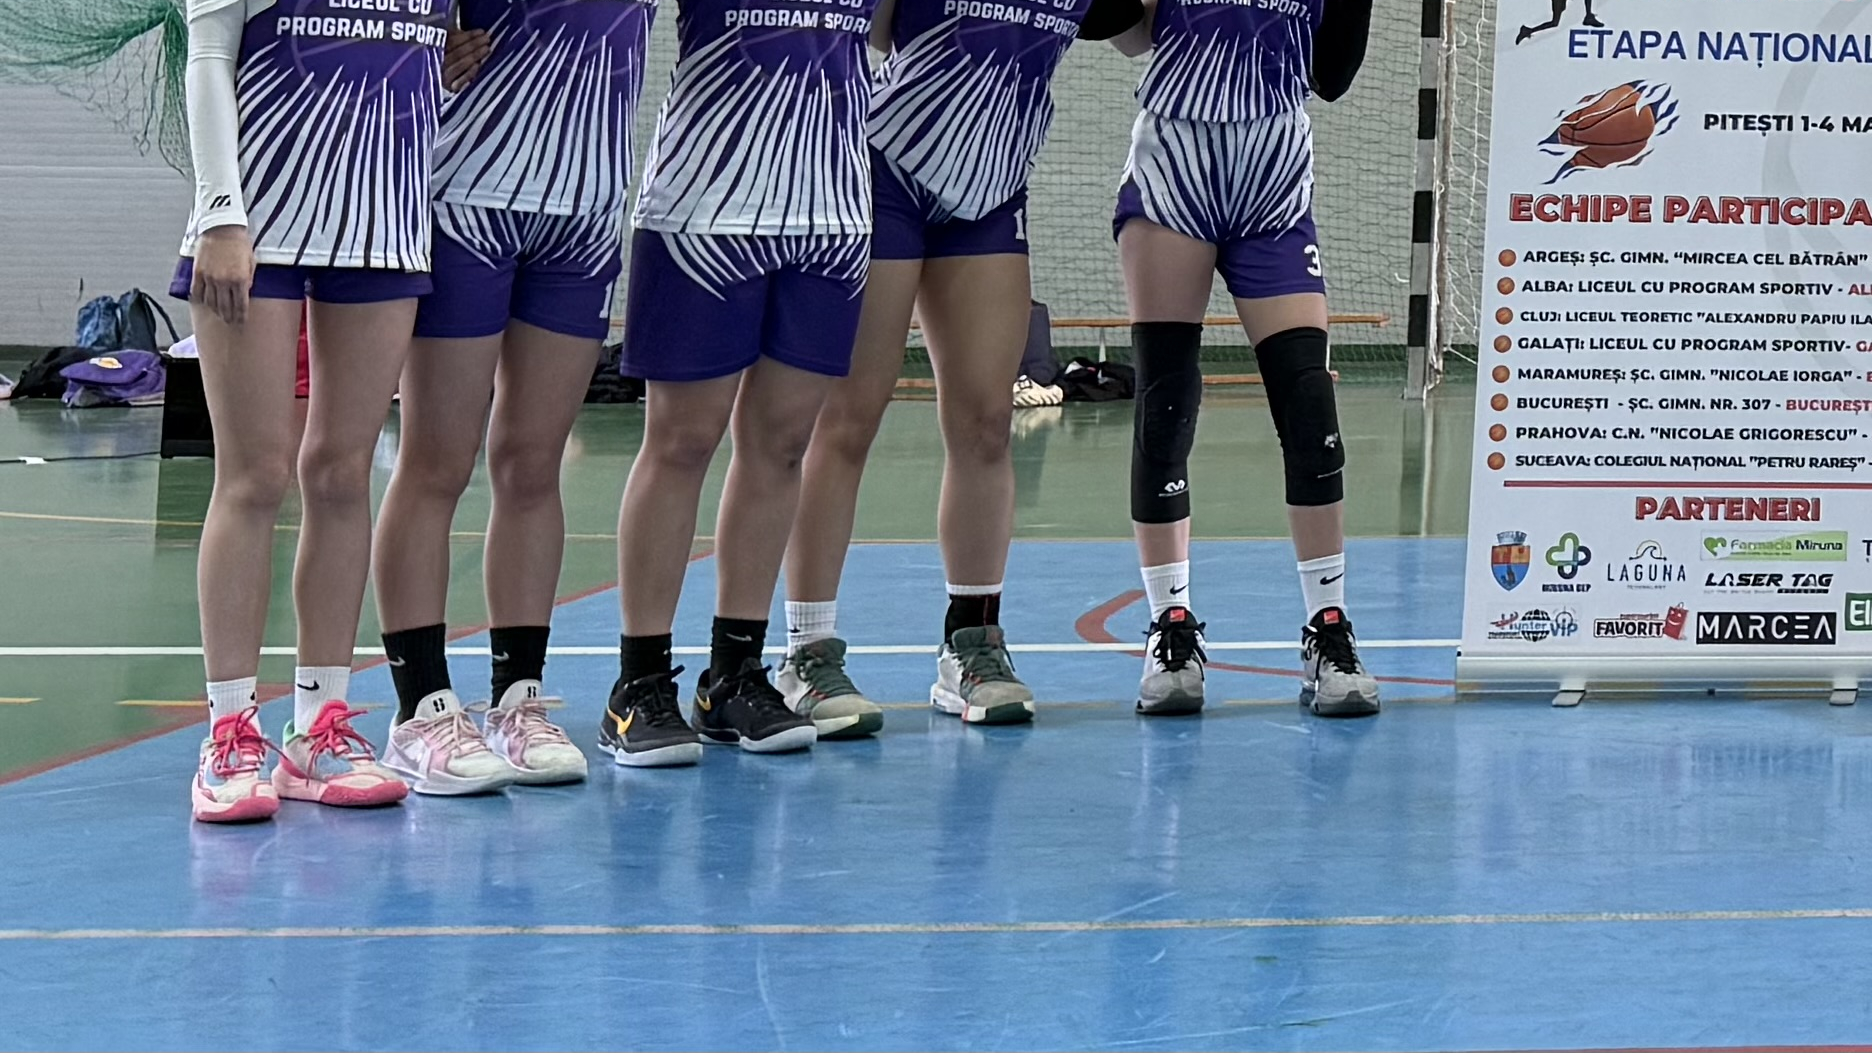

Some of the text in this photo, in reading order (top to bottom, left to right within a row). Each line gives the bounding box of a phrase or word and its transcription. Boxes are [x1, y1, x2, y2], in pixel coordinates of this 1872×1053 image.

[725, 9, 820, 28] PROGRAM
[943, 0, 1031, 25] PROGRAM
[276, 16, 385, 40] PROGRAM
[1567, 29, 1687, 61] ETAPA
[1703, 113, 1794, 138] PITEȘTI
[1800, 115, 1835, 133] 1-4
[1508, 192, 1653, 224] ECHIPE
[1523, 250, 1585, 267] ARGEȘ:
[1620, 252, 1669, 264] GIMN.
[1753, 253, 1785, 266] CEL
[1521, 280, 1574, 293] ALBA:
[1578, 281, 1636, 294] LICEUL
[1641, 281, 1665, 294] CU
[1668, 281, 1755, 295] PROGRAM
[1759, 283, 1833, 296] SPORTIV
[1520, 311, 1562, 323] CLUJ:
[1565, 311, 1617, 323] LICEUL
[1620, 311, 1693, 323] TEORETIC
[1800, 313, 1846, 325] PAPIU
[1517, 337, 1585, 354] GALAȚI:
[1589, 338, 1648, 350] LICEUL
[1653, 338, 1676, 351] CU
[1681, 338, 1767, 352] PROGRAM
[1517, 368, 1627, 384] MARAMUREȘ:
[1659, 369, 1706, 381] GIMN.
[1516, 397, 1609, 413] BUCUREȘTI
[1658, 398, 1706, 410] GIMN.
[1710, 398, 1738, 411] NR.
[1741, 399, 1771, 411] 307
[1515, 427, 1607, 440] PRAHOVA:
[1611, 427, 1645, 440] C.N.
[1515, 455, 1591, 467] SUCEAVA:
[1594, 455, 1667, 467] COLEGIUL
[1669, 455, 1747, 471] NAȚIONAL
[1635, 496, 1822, 522] PARTENERI
[1795, 539, 1843, 551] Miruna
[1607, 563, 1687, 582] LAGUNA
[1705, 572, 1835, 587] LASER TAG
[1596, 621, 1664, 636] FAVORIT
[1698, 614, 1834, 640] MARCEA
